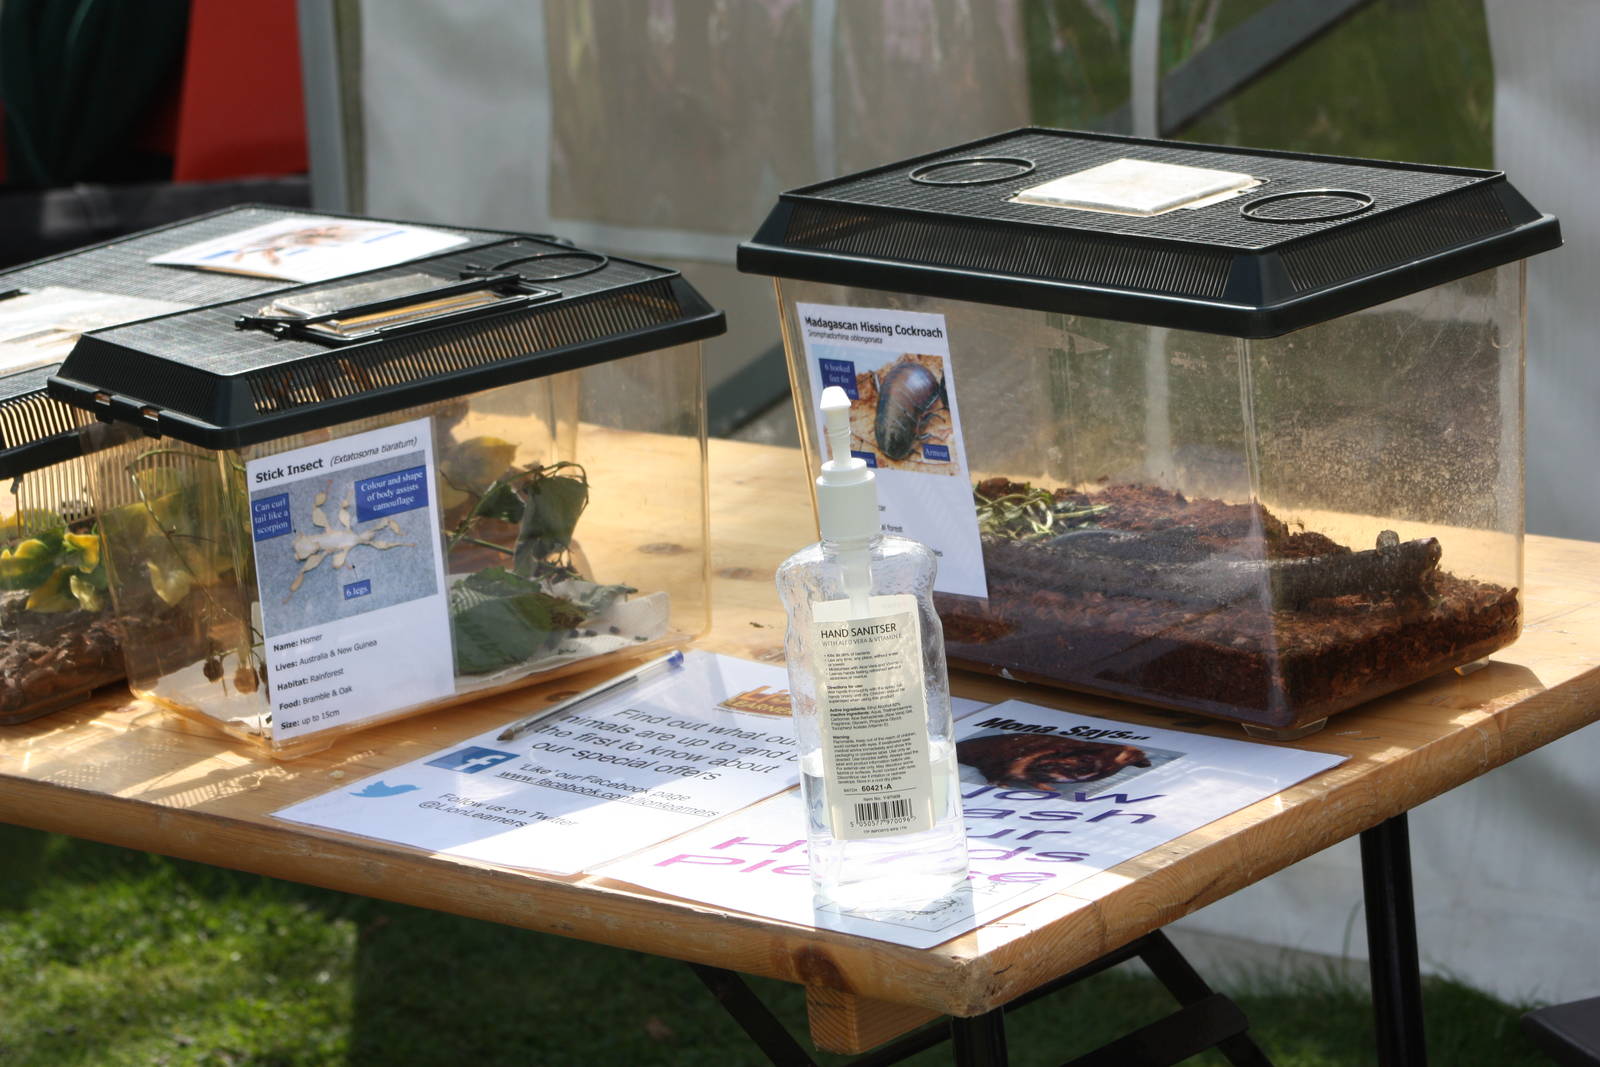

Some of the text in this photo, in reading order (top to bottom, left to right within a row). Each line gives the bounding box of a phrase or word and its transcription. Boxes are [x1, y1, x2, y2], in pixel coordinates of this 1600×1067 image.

[805, 316, 943, 338] Madagascan Hissing Cockroach
[256, 436, 418, 483] Stick Insect (Extatosoma tiaratum)
[361, 470, 424, 492] Colour and shape
[366, 483, 419, 502] of body assists
[372, 495, 416, 512] camouflage
[254, 499, 287, 512] Can curl
[255, 512, 267, 524] tail
[268, 510, 282, 522] like
[257, 520, 288, 535] scorpion
[352, 586, 369, 597] legs
[820, 622, 897, 639] HAND SANITSER
[273, 633, 323, 653] Name: Homer
[275, 638, 378, 672] Lives: Australia & New Guinea
[277, 667, 344, 692] Habitat: Rainforest
[279, 685, 353, 711] Food: Bramble & Oak
[280, 708, 340, 730] Size: up to 15cm
[613, 708, 667, 725] Find
[667, 719, 705, 731] out
[708, 723, 766, 741] what
[973, 717, 1152, 741] Mona Says...
[533, 722, 780, 774] the first to know about
[559, 714, 635, 734] nimals
[635, 729, 676, 741] are
[677, 735, 709, 748] up
[710, 740, 736, 751] to
[737, 743, 789, 761] and
[531, 742, 722, 782] our special offers
[556, 771, 582, 781] our
[580, 774, 650, 794] Facebook
[651, 790, 692, 803] page
[861, 783, 892, 792] 60421-A
[418, 801, 527, 828] @LionLearners
[438, 793, 579, 827] Follow us on Twitter
[963, 809, 1157, 824] ash
[966, 827, 1072, 841] ur
